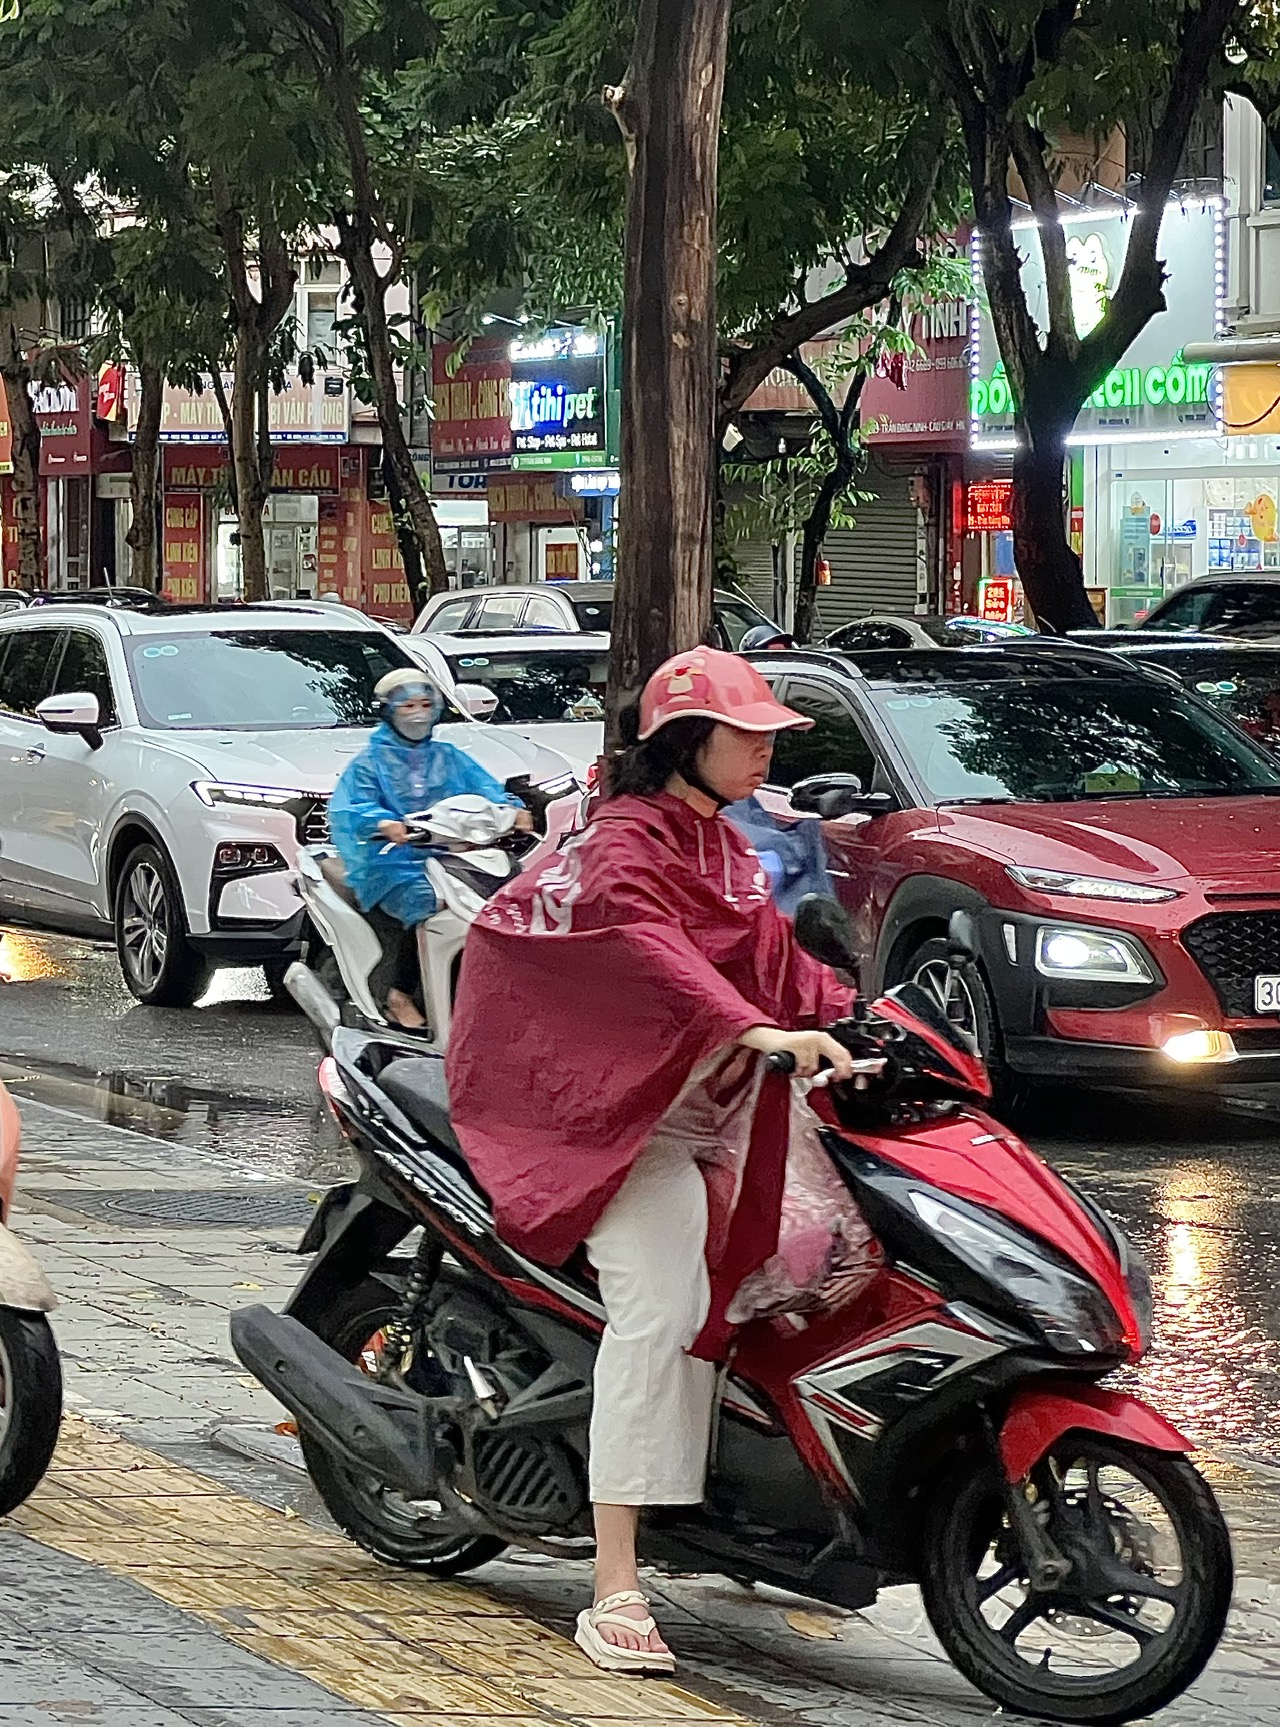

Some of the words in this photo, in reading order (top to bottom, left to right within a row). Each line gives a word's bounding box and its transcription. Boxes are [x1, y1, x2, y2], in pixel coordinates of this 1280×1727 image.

[283, 397, 305, 425] VĂN
[171, 464, 207, 486] MÁY
[270, 464, 293, 487] ÀN
